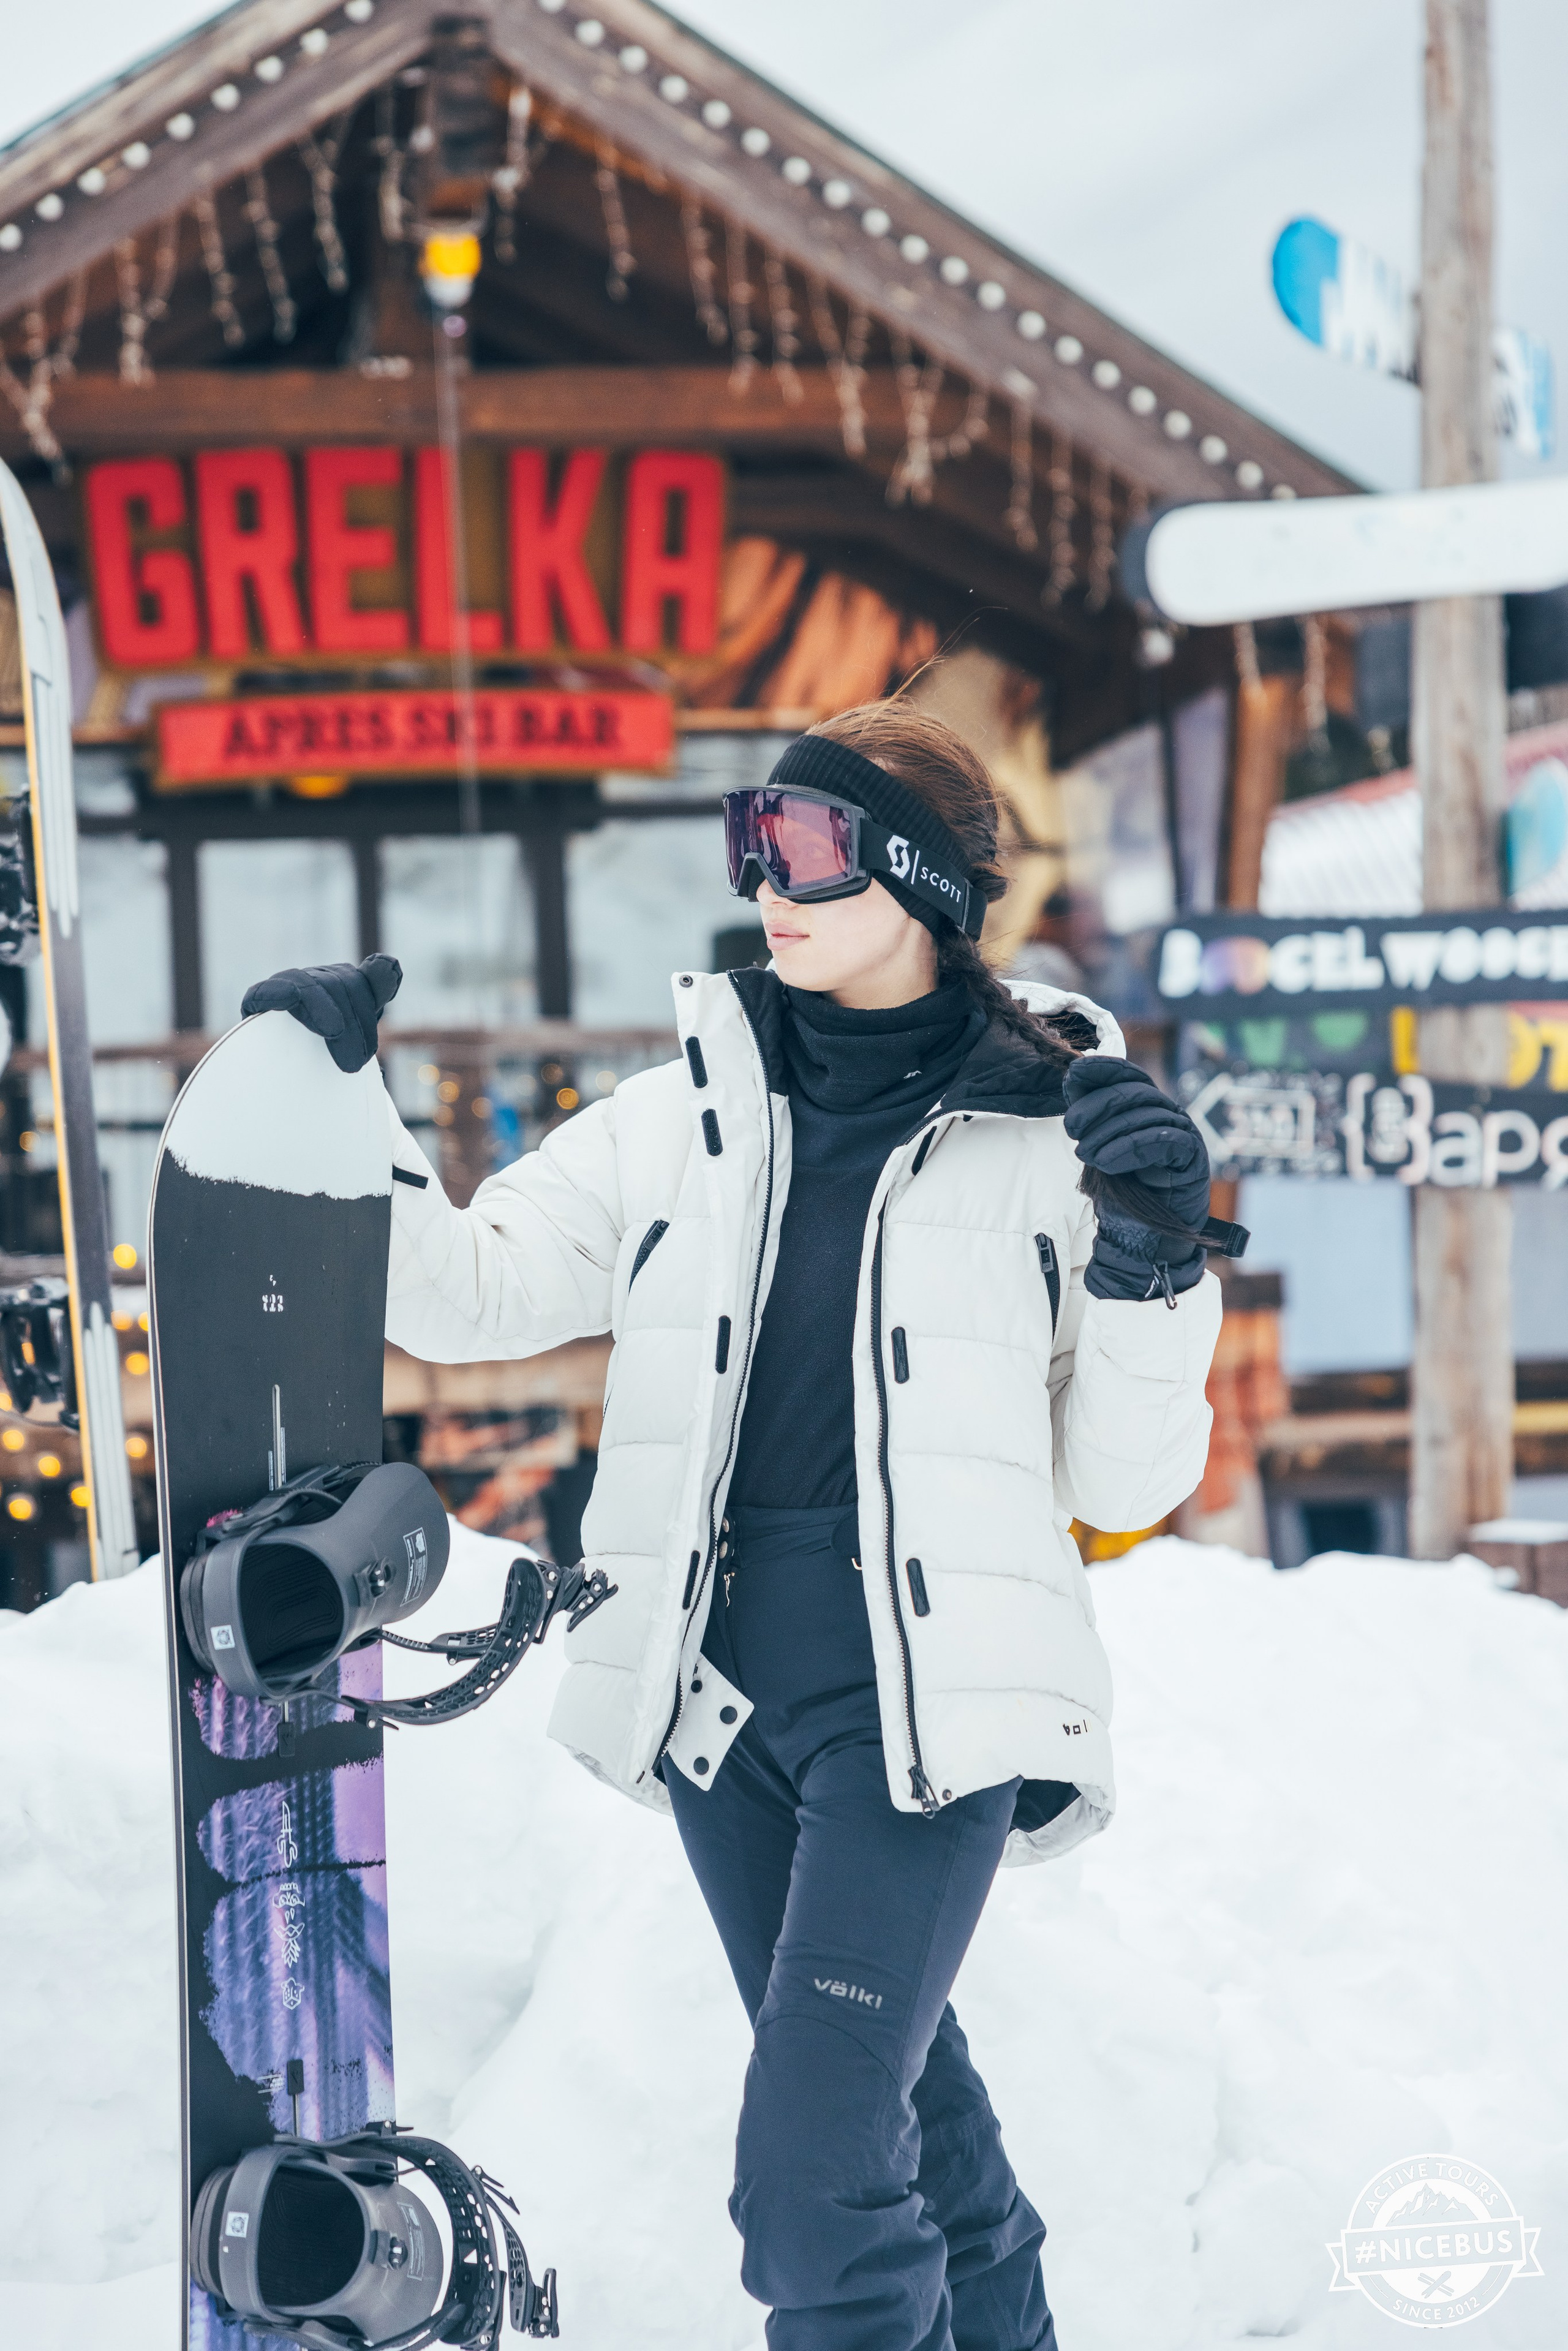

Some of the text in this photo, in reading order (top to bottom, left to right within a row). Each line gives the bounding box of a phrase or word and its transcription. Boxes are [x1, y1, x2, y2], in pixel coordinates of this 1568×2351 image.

[85, 445, 727, 666] GRELKA
[515, 703, 623, 749] BAR
[921, 867, 961, 903] SCOTT
